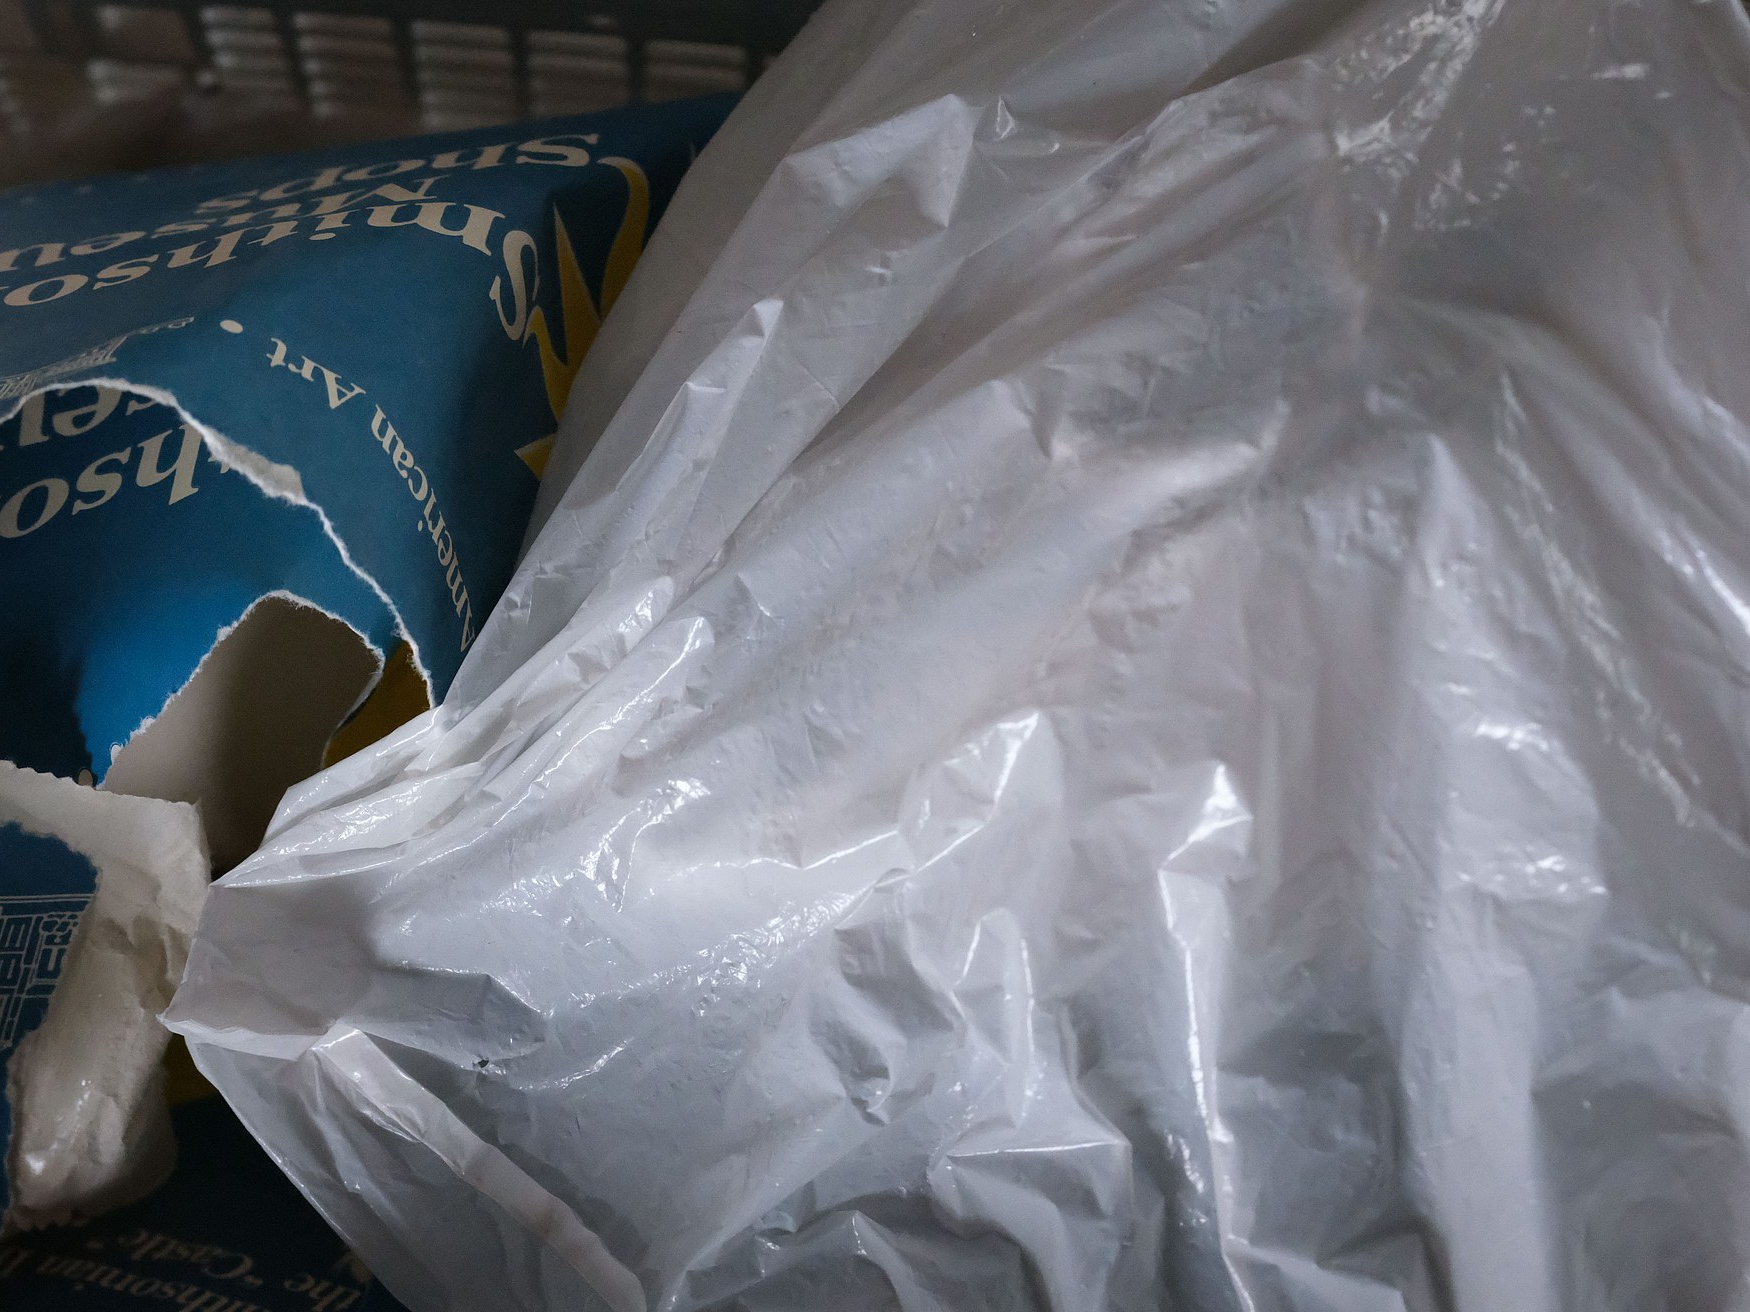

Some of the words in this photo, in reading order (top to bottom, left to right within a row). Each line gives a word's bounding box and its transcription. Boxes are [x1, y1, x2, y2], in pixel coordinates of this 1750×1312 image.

[196, 131, 598, 215] Shops
[265, 337, 364, 411] Art
[368, 405, 477, 653] American
[283, 1270, 361, 1312] the
